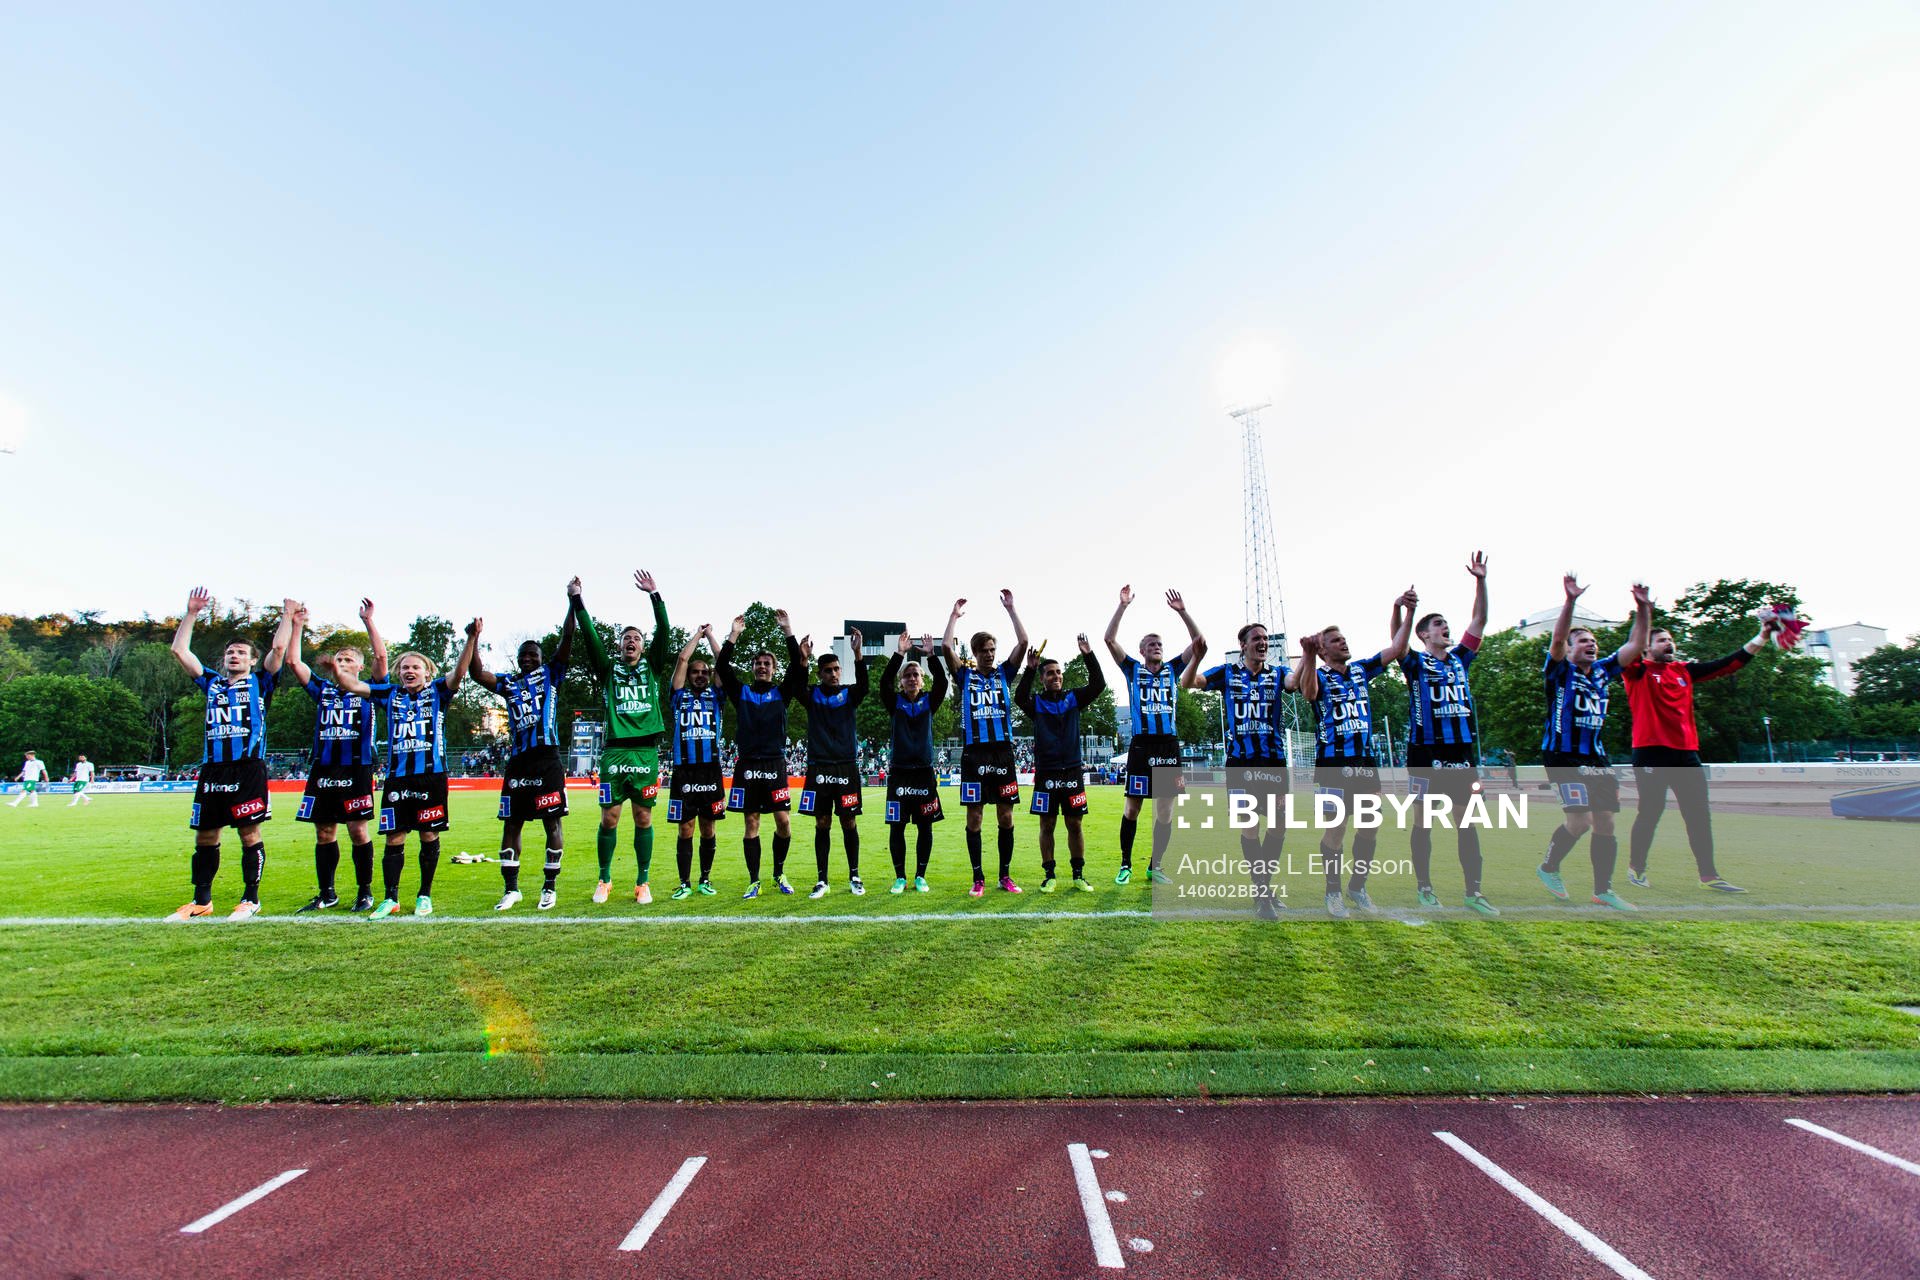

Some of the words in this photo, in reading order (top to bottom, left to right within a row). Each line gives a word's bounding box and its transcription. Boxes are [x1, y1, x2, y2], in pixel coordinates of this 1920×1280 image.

[615, 685, 651, 700] UNT.
[971, 690, 1005, 706] UNT.
[1140, 688, 1173, 701] UNT.
[1430, 685, 1469, 702] UNT.
[206, 705, 251, 724] UNT.
[321, 710, 362, 725] UNT.
[1234, 702, 1273, 719] UNT.
[680, 711, 717, 726] UNT.
[393, 720, 434, 738] UNT.
[619, 765, 651, 774] Koneo
[347, 799, 373, 811] JÖTA
[538, 796, 560, 807] JÖTA
[236, 802, 263, 817] JÖTA
[419, 810, 442, 821] JÖTA
